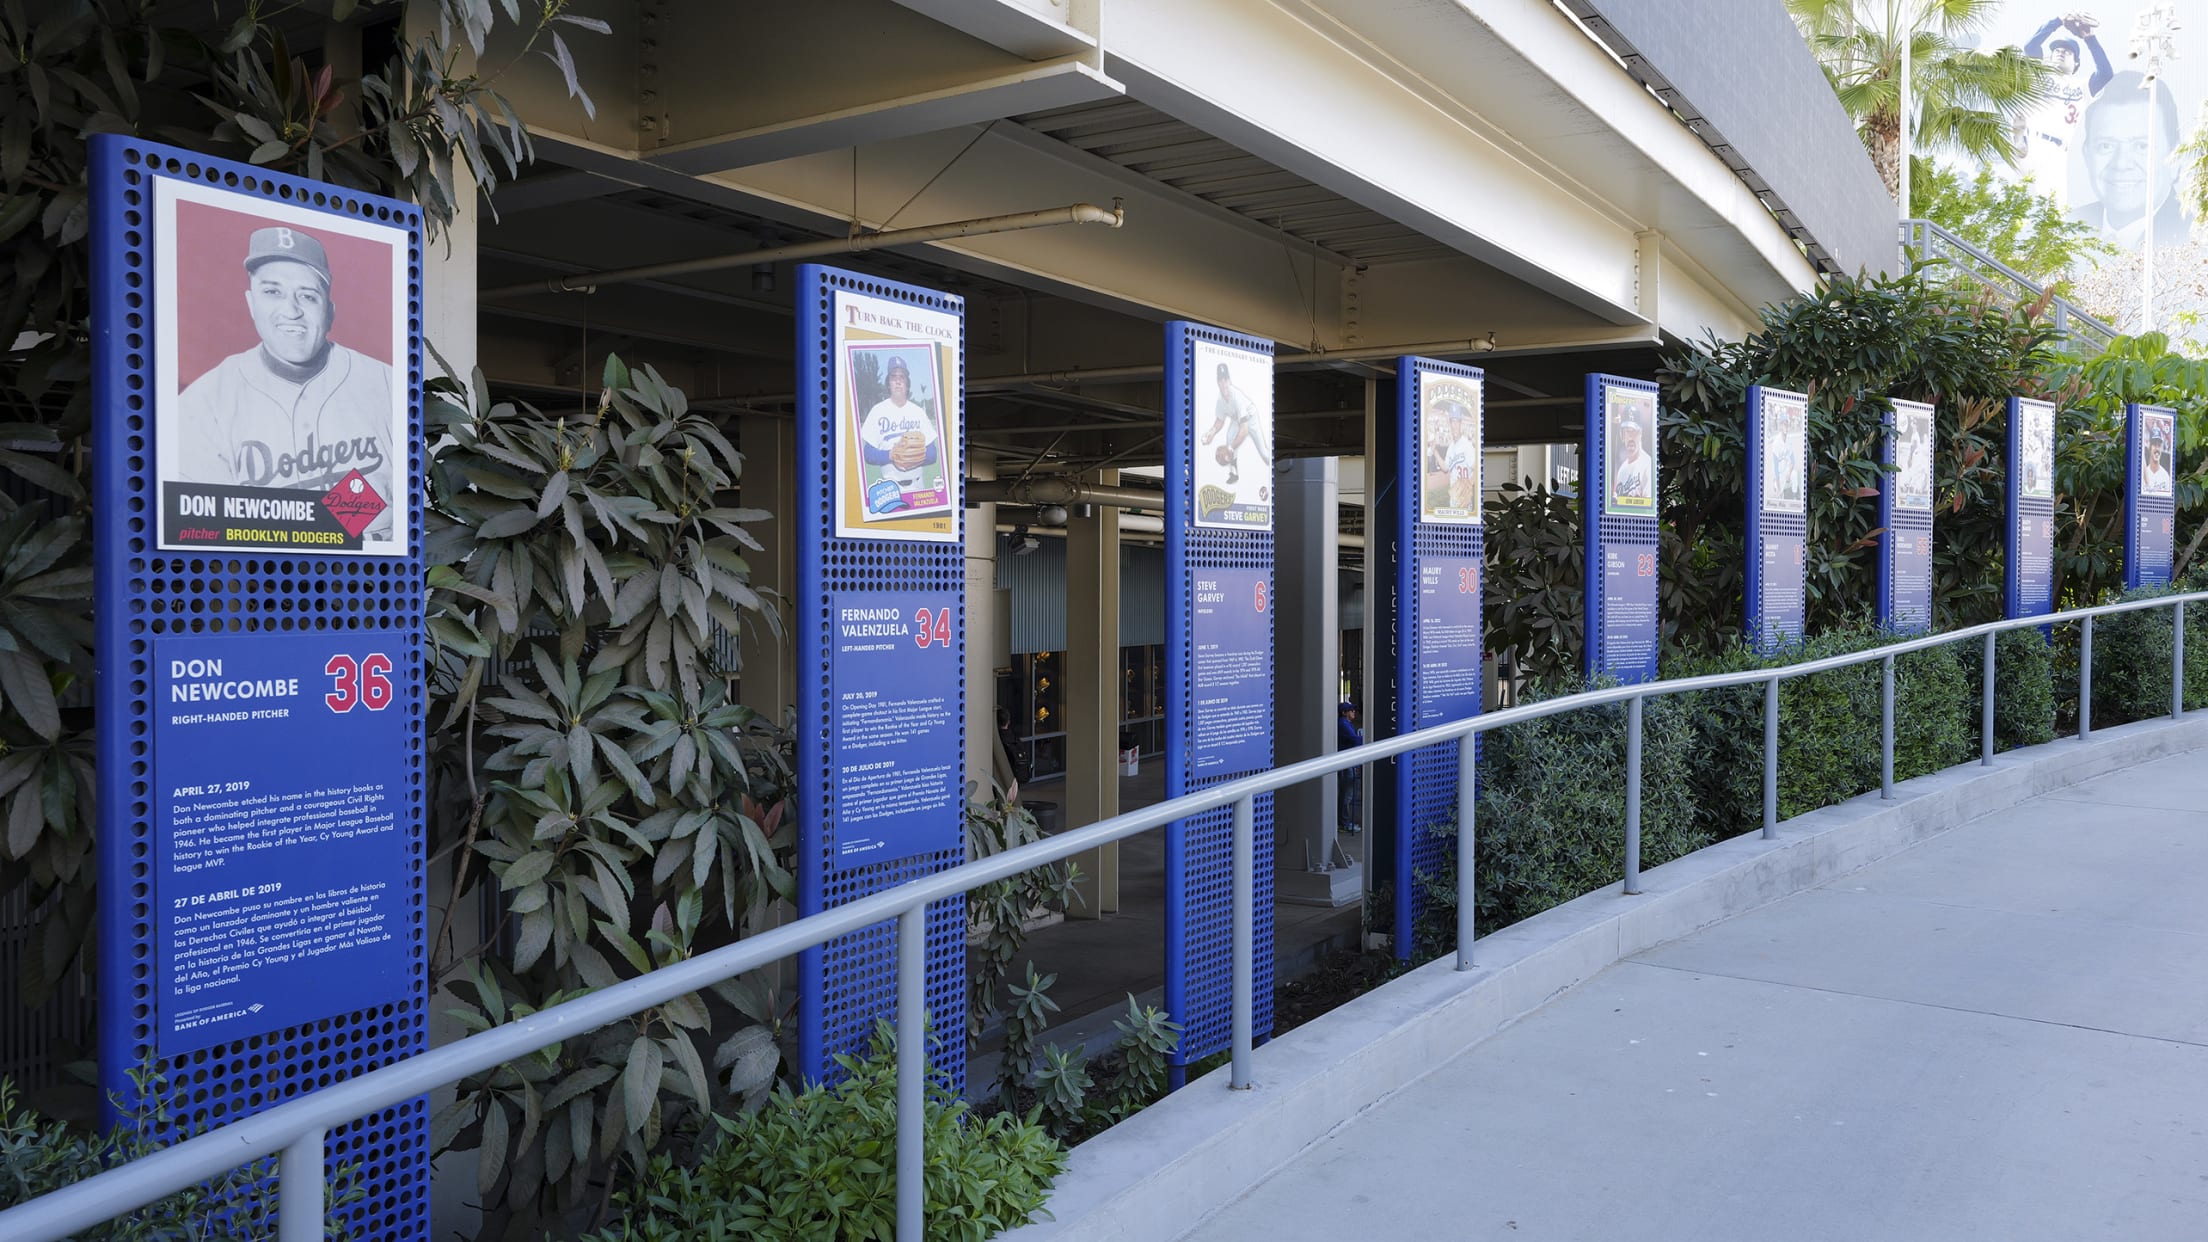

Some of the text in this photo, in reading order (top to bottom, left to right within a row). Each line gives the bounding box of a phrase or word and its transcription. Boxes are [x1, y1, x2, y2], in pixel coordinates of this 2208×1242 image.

[279, 227, 295, 249] B
[845, 305, 952, 339] TURN BACK THE CLOCK
[237, 432, 383, 490] Dodgers
[1457, 466, 1468, 480] 30
[180, 494, 315, 521] DON NEWCOMBE
[326, 492, 381, 516] Dodgers
[1224, 512, 1268, 523] STEVE GARVEY
[179, 528, 344, 545] pitcher BROOKLYN DODGERS
[1423, 567, 1441, 575] MAURY
[1638, 554, 1654, 576] 23
[1198, 581, 1216, 590] STEVE
[1459, 568, 1477, 593] 30
[1198, 593, 1224, 603] GARVEY
[1255, 581, 1266, 612] 6
[842, 608, 899, 621] FERNANDO
[842, 624, 908, 637] VALENZUELA
[915, 608, 951, 648] 34
[171, 660, 222, 679] DON
[171, 679, 298, 702] NEWCOMBE
[325, 652, 392, 714] 36
[172, 708, 288, 724] RIGHT-HANDED PITCHER
[858, 763, 873, 771] JULIO
[882, 760, 894, 768] 2019
[173, 780, 249, 797] APRIL 27, 2019
[173, 805, 190, 813] Don
[193, 799, 238, 810] Newcombe
[241, 795, 267, 805] etched
[269, 794, 279, 802] his
[352, 783, 373, 792] books
[173, 815, 192, 825] both
[203, 810, 248, 821] dominating
[250, 806, 277, 817] pitcher
[279, 803, 294, 812] and
[303, 799, 345, 809] courageous
[346, 795, 362, 804] Civil
[364, 793, 384, 802] Rights
[173, 827, 205, 838] pioneer
[208, 823, 225, 832] who
[227, 819, 254, 830] helped
[257, 816, 291, 826] integrate
[293, 808, 336, 823] professional
[338, 805, 368, 815] baseball
[174, 838, 196, 848] 1946.
[198, 837, 210, 845] He
[213, 834, 244, 843] became
[247, 830, 259, 838] the
[262, 828, 276, 836] first
[278, 826, 302, 836] player
[313, 821, 335, 829] Major
[337, 818, 363, 827] League
[364, 812, 393, 823] Baseball
[173, 851, 201, 860] history
[215, 846, 229, 854] win
[231, 844, 244, 852] the
[246, 840, 272, 850] Rookie
[274, 837, 282, 846] of
[285, 836, 297, 844] the
[299, 834, 317, 842] Year,
[319, 831, 329, 840] Cy
[331, 830, 353, 838] Young
[355, 824, 378, 834] Award
[380, 822, 393, 831] and
[173, 857, 224, 872] league MVP.
[174, 882, 281, 908] 27 DE ABRIL DE 2019
[174, 915, 191, 924] Don
[194, 906, 239, 920] Newcombe
[242, 904, 261, 913] puso
[273, 896, 302, 906] nombre
[328, 889, 347, 897] libros
[360, 881, 385, 891] historia
[174, 927, 197, 936] como
[212, 916, 248, 928] lanzador
[250, 909, 291, 921] dominante
[311, 901, 339, 910] hombre
[340, 895, 368, 905] valiente
[174, 939, 185, 947] los
[188, 932, 226, 945] Derechos
[229, 926, 254, 937] Civiles
[256, 924, 271, 933] que
[273, 918, 297, 929] ayudó
[307, 912, 336, 922] integrar
[346, 904, 371, 915] béisbol
[174, 1021, 198, 1031] BANK
[199, 1018, 209, 1026] OF
[211, 1009, 247, 1023] AMERICA
